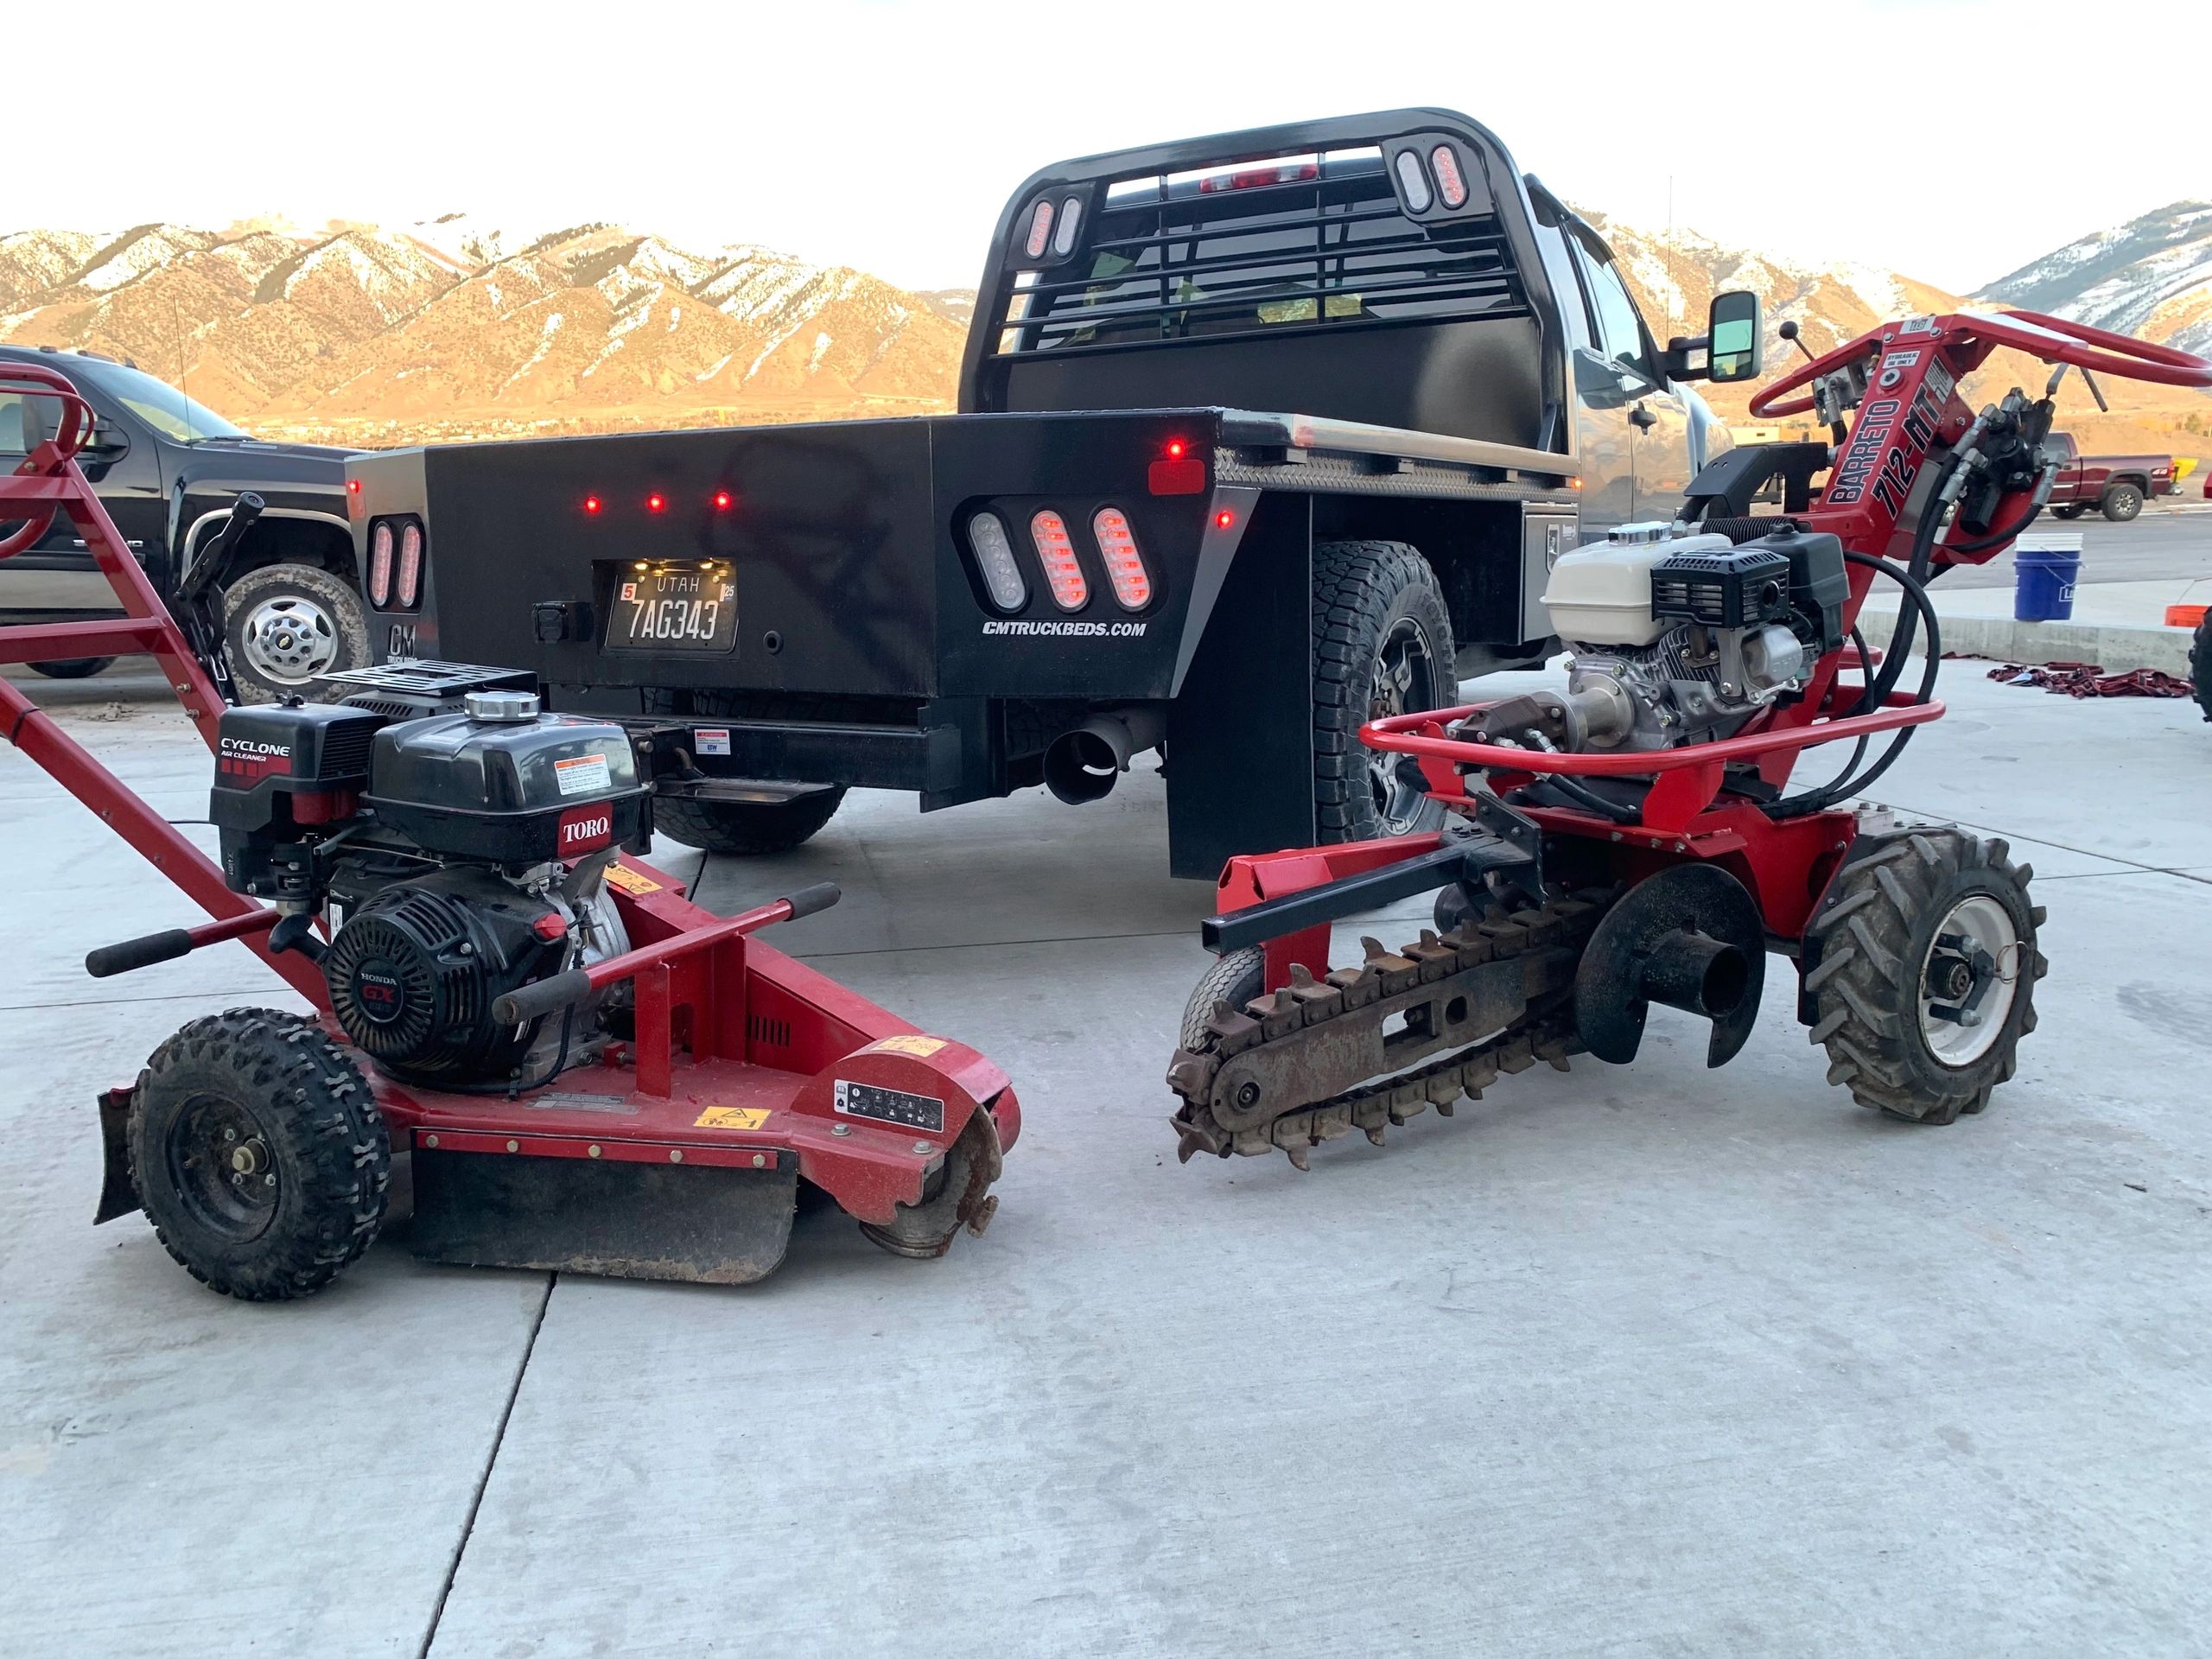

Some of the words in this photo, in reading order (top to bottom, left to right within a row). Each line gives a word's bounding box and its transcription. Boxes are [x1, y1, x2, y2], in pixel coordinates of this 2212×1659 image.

[1827, 398, 1901, 505] BARRETO
[1871, 382, 1941, 521] 712-MT
[624, 585, 633, 599] 5
[657, 576, 700, 593] UTAH
[724, 585, 734, 597] 25
[629, 600, 719, 640] 7AG343
[982, 621, 1147, 637] CMTRUCKBEDS.COM
[389, 623, 416, 656] CM
[220, 737, 291, 757] CYCLONE
[233, 752, 267, 762] CLEANER
[563, 817, 608, 843] TORO
[360, 972, 397, 985] HONDA
